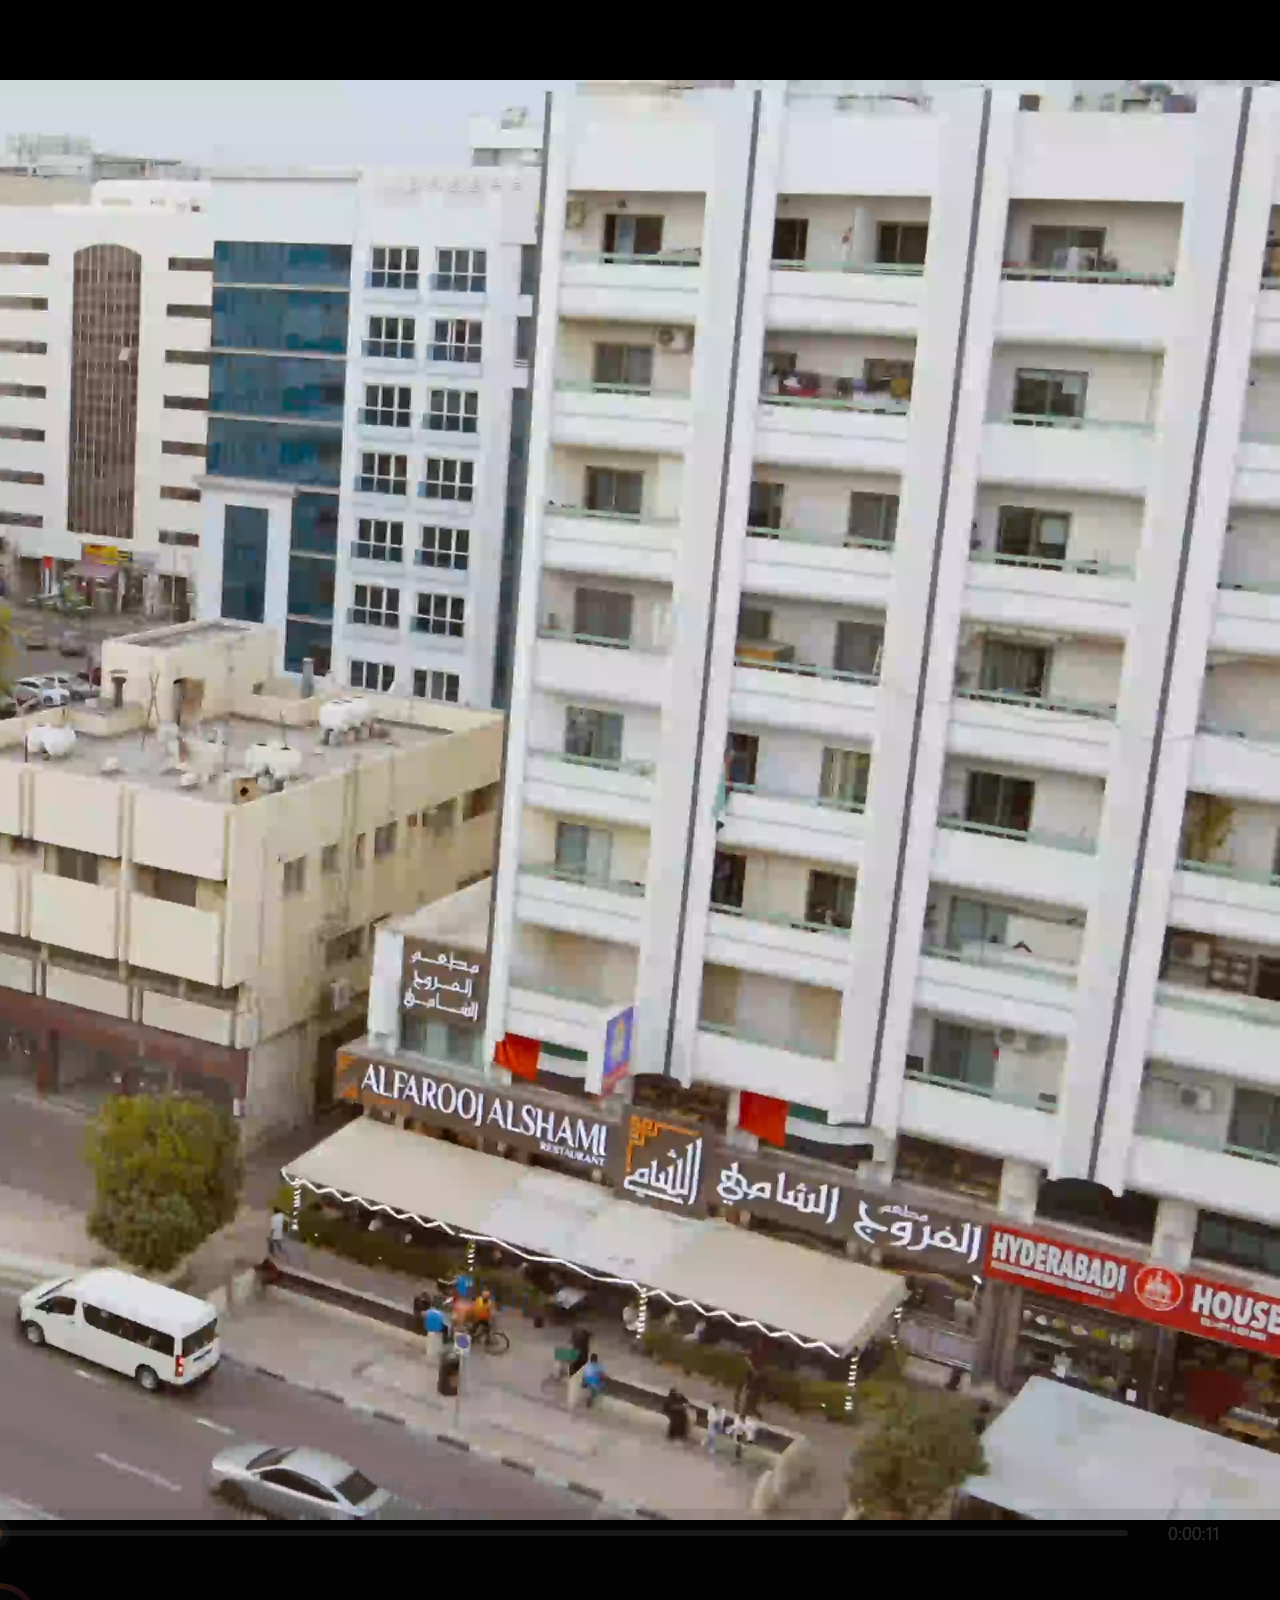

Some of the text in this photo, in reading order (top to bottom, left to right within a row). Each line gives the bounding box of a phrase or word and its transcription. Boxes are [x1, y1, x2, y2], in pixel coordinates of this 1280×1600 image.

[410, 951, 480, 974] مطعم
[412, 970, 473, 998] الفروج
[403, 987, 479, 1022] الشامي
[486, 1097, 608, 1157] ALSHAMI
[539, 1140, 605, 1167] RESTAURANT
[715, 1160, 983, 1264] الفروج الشامي
[878, 1204, 929, 1223] مطعم
[991, 1230, 1128, 1293] HYDERABADI
[1190, 1283, 1280, 1335] HOUSE
